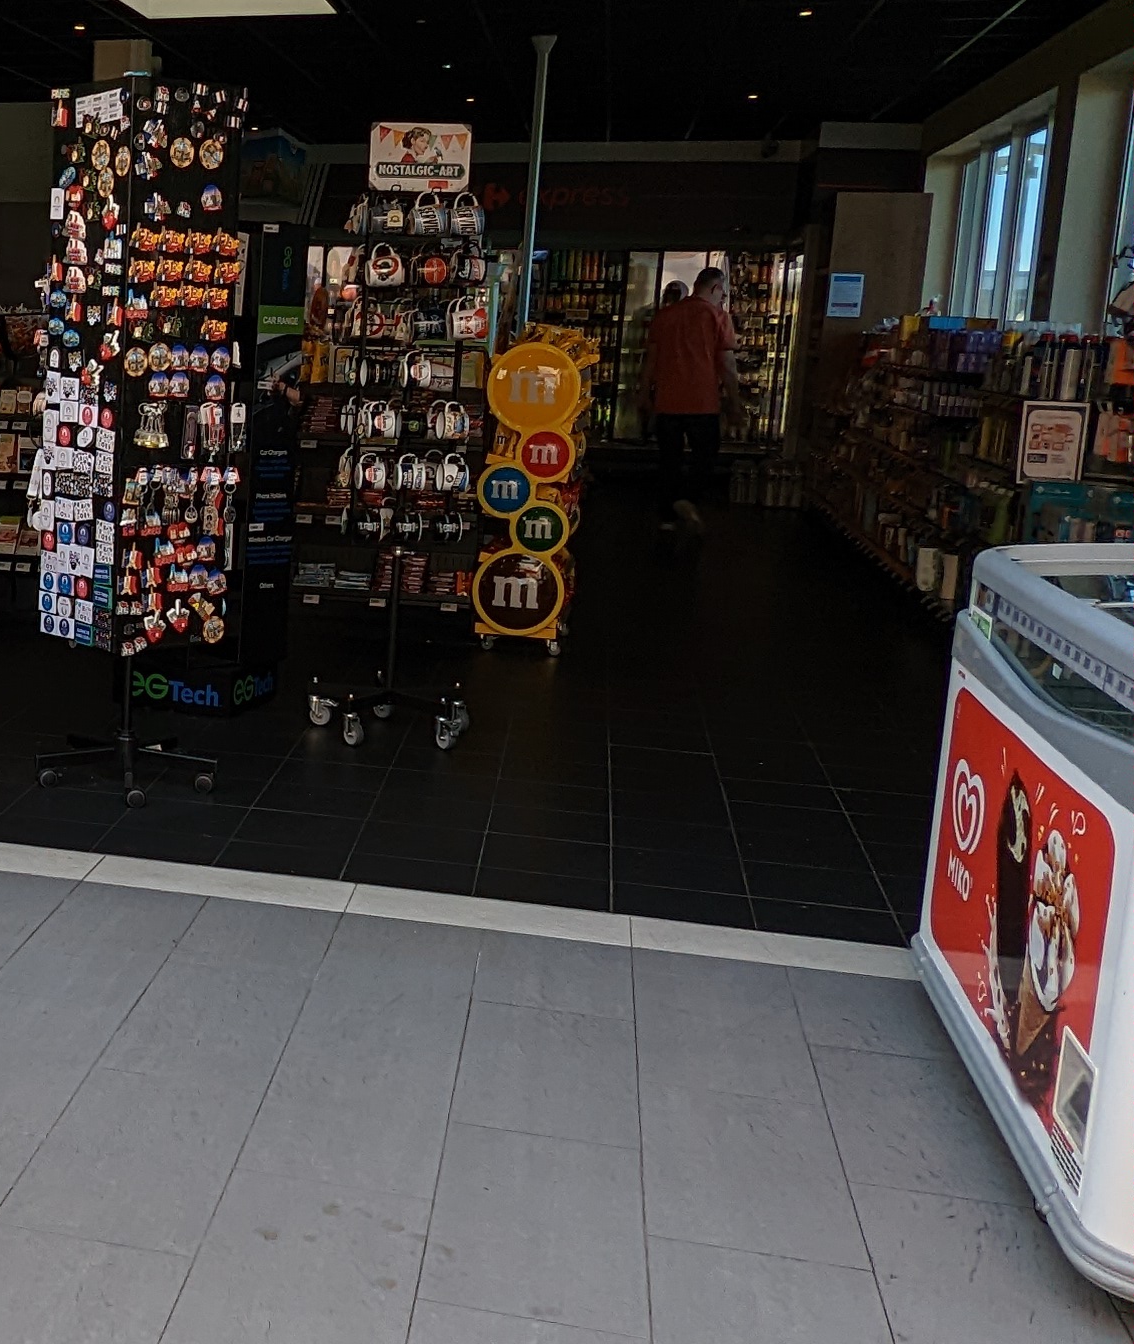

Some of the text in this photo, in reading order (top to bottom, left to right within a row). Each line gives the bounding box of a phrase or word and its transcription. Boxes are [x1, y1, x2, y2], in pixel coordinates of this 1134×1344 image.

[378, 163, 461, 178] NOSTALGIC-ART
[262, 316, 299, 326] CAR RANGE
[508, 369, 558, 404] m
[529, 443, 560, 465] m
[490, 479, 520, 500] m
[523, 516, 553, 540] m
[491, 574, 539, 610] m
[947, 848, 970, 902] MIKO
